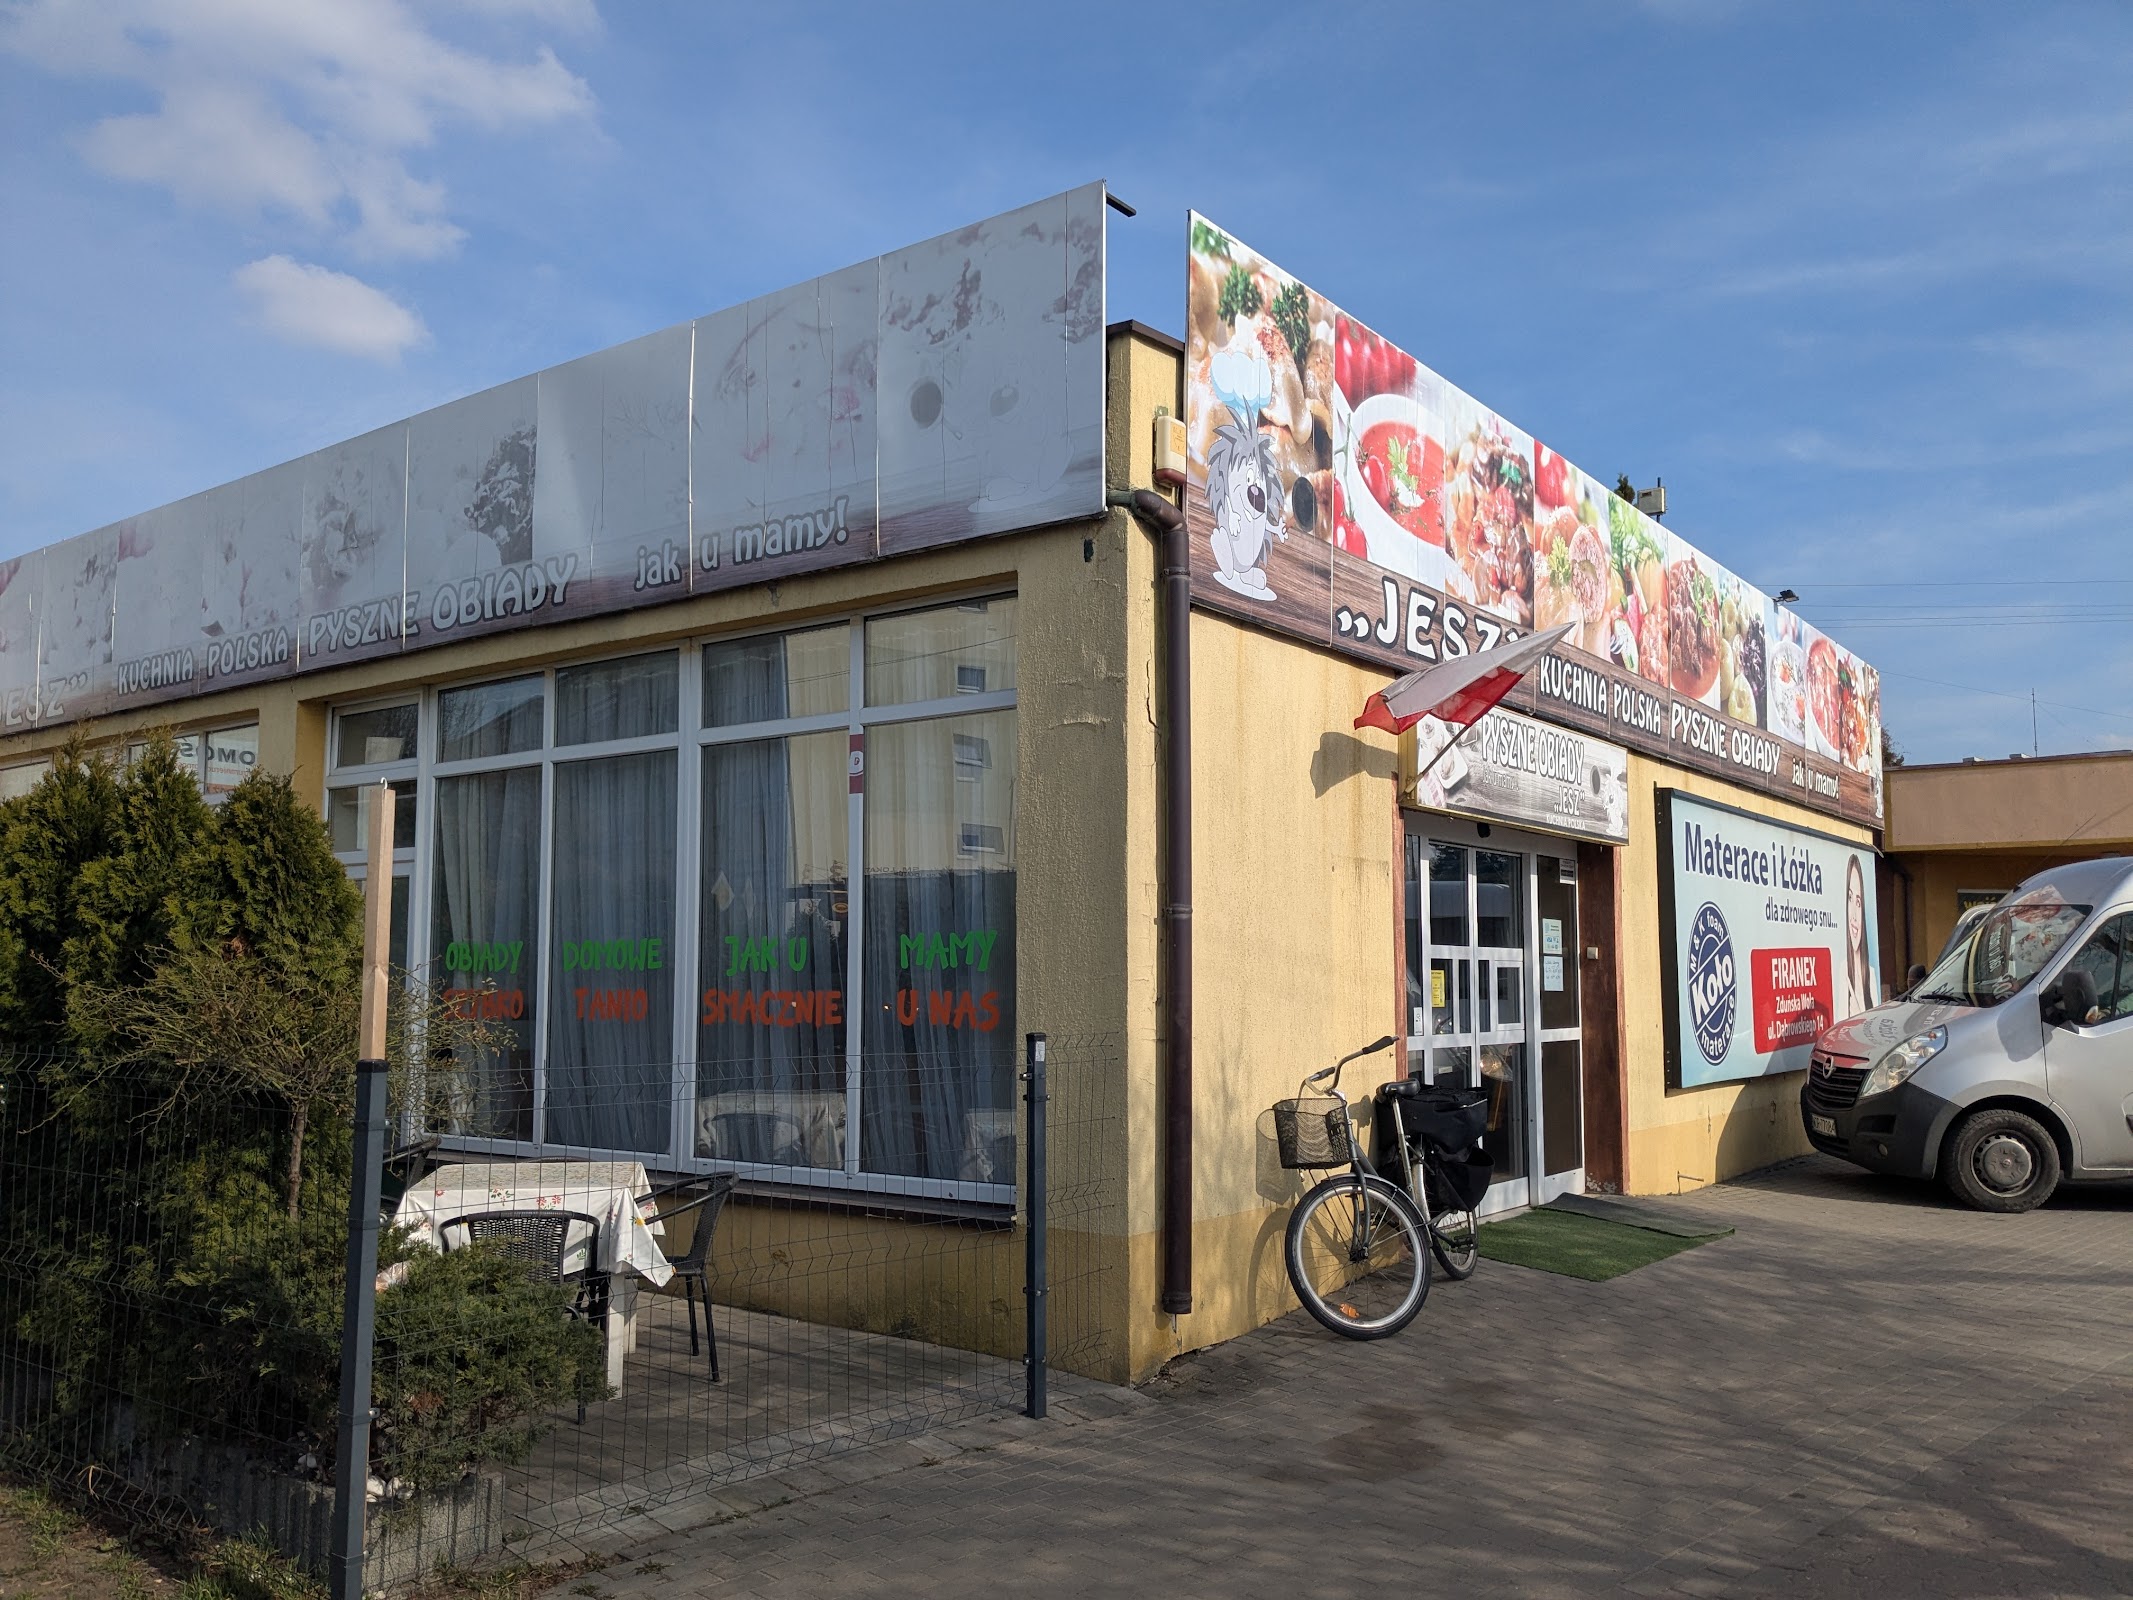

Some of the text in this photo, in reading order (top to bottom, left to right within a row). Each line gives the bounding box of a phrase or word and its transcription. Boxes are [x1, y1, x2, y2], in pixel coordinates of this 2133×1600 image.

[634, 495, 849, 592] jak u mamy!
[309, 553, 578, 656] PYSZNE OBIADY
[118, 626, 289, 696] KUCHNIA POLSKA
[1540, 654, 1661, 735] KUCHNIA POLSKA
[1482, 714, 1584, 785] PYSZNE OBIADY
[1670, 700, 1781, 776] PYSZNE OBIADY
[1791, 758, 1839, 800] jak u mamy!
[1547, 813, 1586, 831] KUCHNIA POLSKA
[1685, 821, 1823, 895] Materace i Łóżka
[1690, 911, 1725, 973] M & K foam
[1765, 896, 1838, 932] dla zdrowego snu...
[445, 929, 998, 976] OBIADY DOMOWE JAK U MAMY
[1771, 956, 1817, 990] FIRANEX
[574, 986, 648, 1023] TANIO
[703, 988, 842, 1029] SMACZNIE
[896, 989, 919, 1026] U
[929, 990, 1001, 1032] NAS
[1692, 954, 1733, 1026] Koło
[1776, 994, 1800, 1015] Zduńska
[1701, 995, 1735, 1056] materace
[1767, 1020, 1776, 1041] ul.
[1776, 1016, 1817, 1042] Dąbrowskiego
[1816, 1014, 1824, 1032] 14
